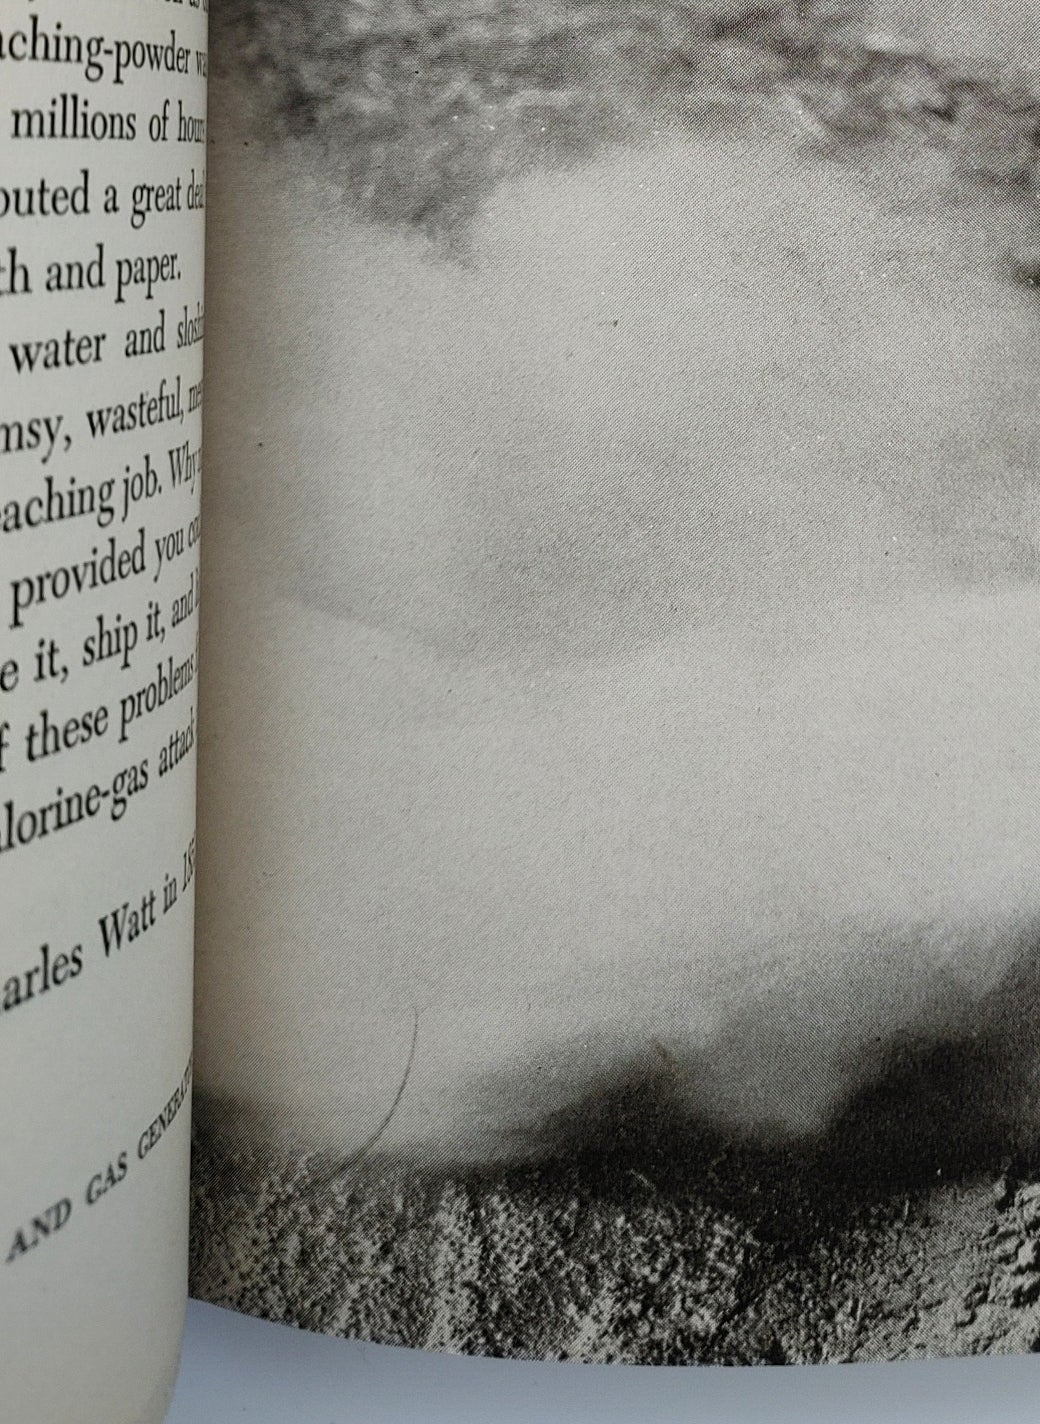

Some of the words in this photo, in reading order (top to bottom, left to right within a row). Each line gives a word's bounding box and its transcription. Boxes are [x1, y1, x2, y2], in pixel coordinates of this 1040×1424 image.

[12, 93, 136, 141] millions
[149, 99, 170, 142] of
[104, 184, 119, 214] a
[130, 176, 182, 230] great
[46, 242, 105, 292] and
[115, 252, 181, 304] paper.
[9, 329, 107, 374] water
[124, 307, 166, 358] and
[86, 375, 184, 439] wasteful,
[121, 453, 162, 523] job.
[9, 526, 146, 630] provided
[154, 527, 184, 583] you
[34, 638, 69, 684] it,
[82, 613, 138, 670] ship
[146, 601, 165, 643] it,
[172, 572, 194, 627] and
[25, 706, 108, 762] these
[118, 652, 195, 744] problems
[98, 889, 156, 958] Watt
[162, 873, 178, 915] in
[6, 1198, 72, 1263] AND
[86, 1151, 127, 1205] GAS
